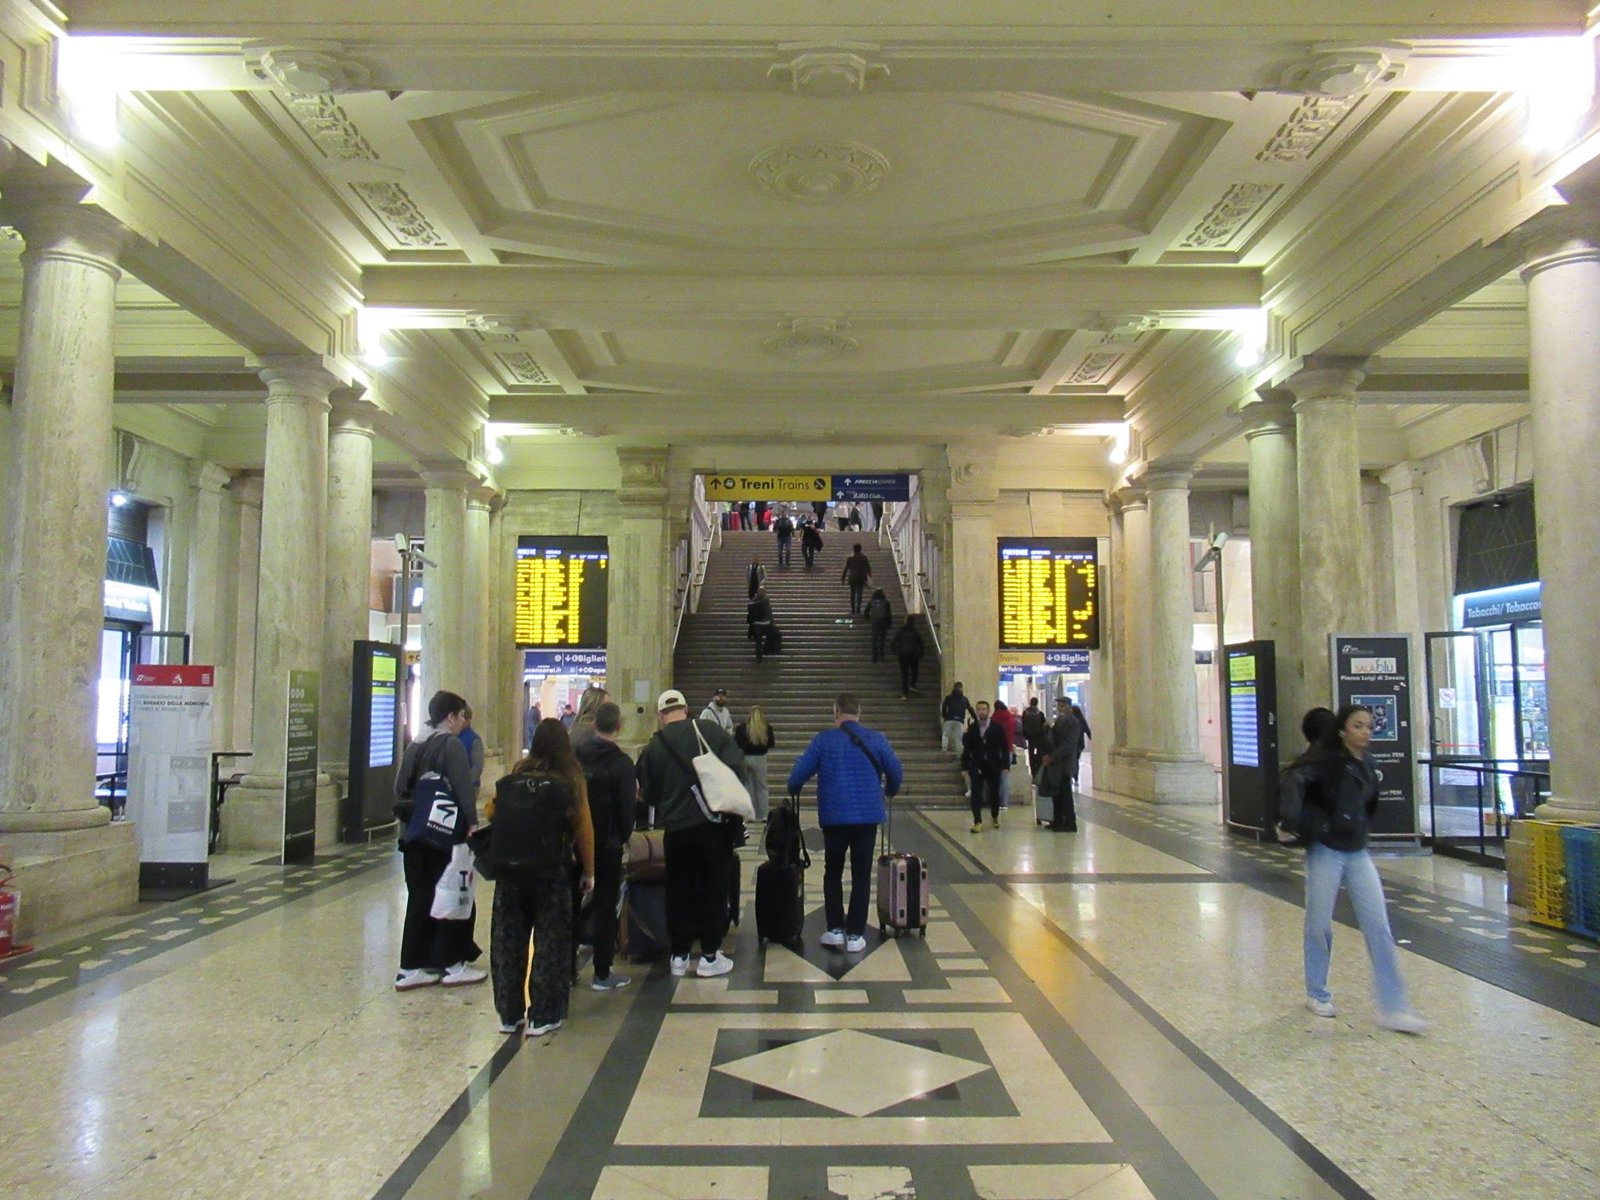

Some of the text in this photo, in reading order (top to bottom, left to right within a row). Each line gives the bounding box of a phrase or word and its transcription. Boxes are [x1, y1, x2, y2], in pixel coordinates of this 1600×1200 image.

[741, 478, 810, 490] Treni Trains
[1061, 653, 1090, 663] Bigliet
